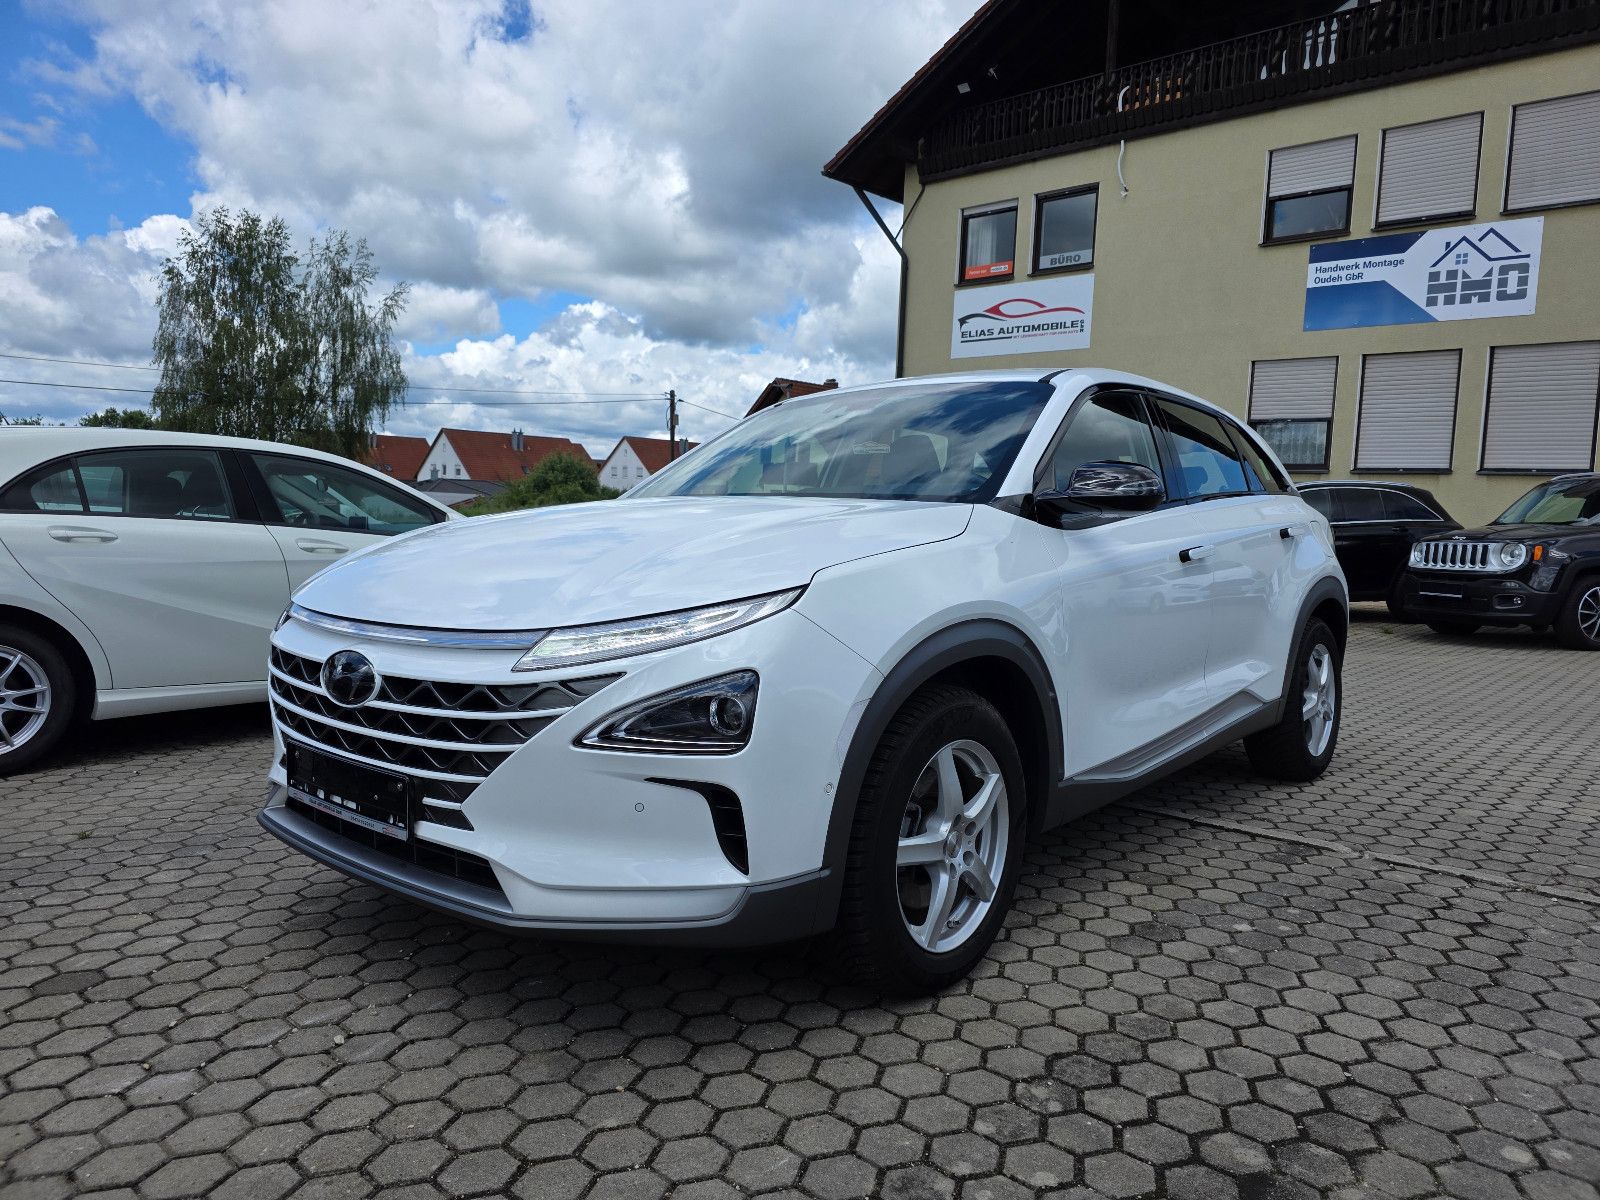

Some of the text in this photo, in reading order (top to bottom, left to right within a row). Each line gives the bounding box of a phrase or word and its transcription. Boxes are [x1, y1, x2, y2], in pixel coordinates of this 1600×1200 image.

[1050, 254, 1081, 266] BÜRO
[1315, 258, 1405, 274] Handwerk Montage
[1314, 272, 1364, 284] Oudeh GbR
[961, 328, 994, 339] ELIAS
[997, 319, 1079, 335] AUTOMOBILE
